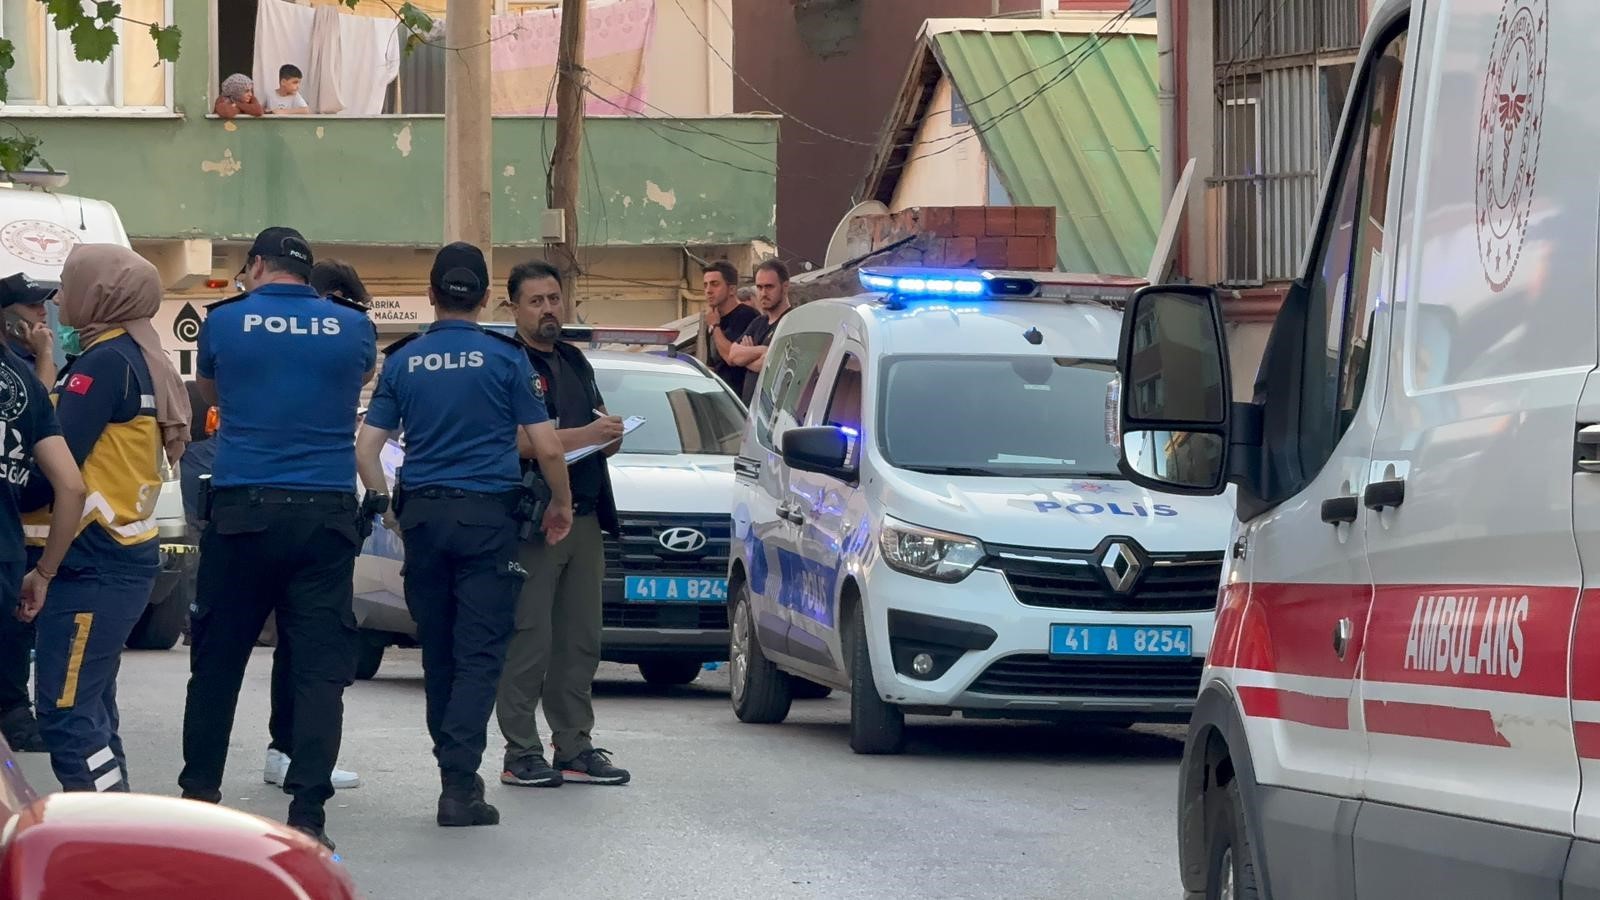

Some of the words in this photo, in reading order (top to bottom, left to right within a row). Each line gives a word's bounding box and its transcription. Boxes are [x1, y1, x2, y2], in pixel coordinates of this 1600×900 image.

[369, 300, 401, 309] ABRİKA
[374, 309, 418, 320] MAĞAZASI
[636, 578, 656, 598] 41
[666, 579, 678, 598] A
[1065, 628, 1089, 651] 41
[1107, 629, 1119, 651] A
[1133, 629, 1186, 653] 8254
[1404, 595, 1529, 679] AMBULANS
